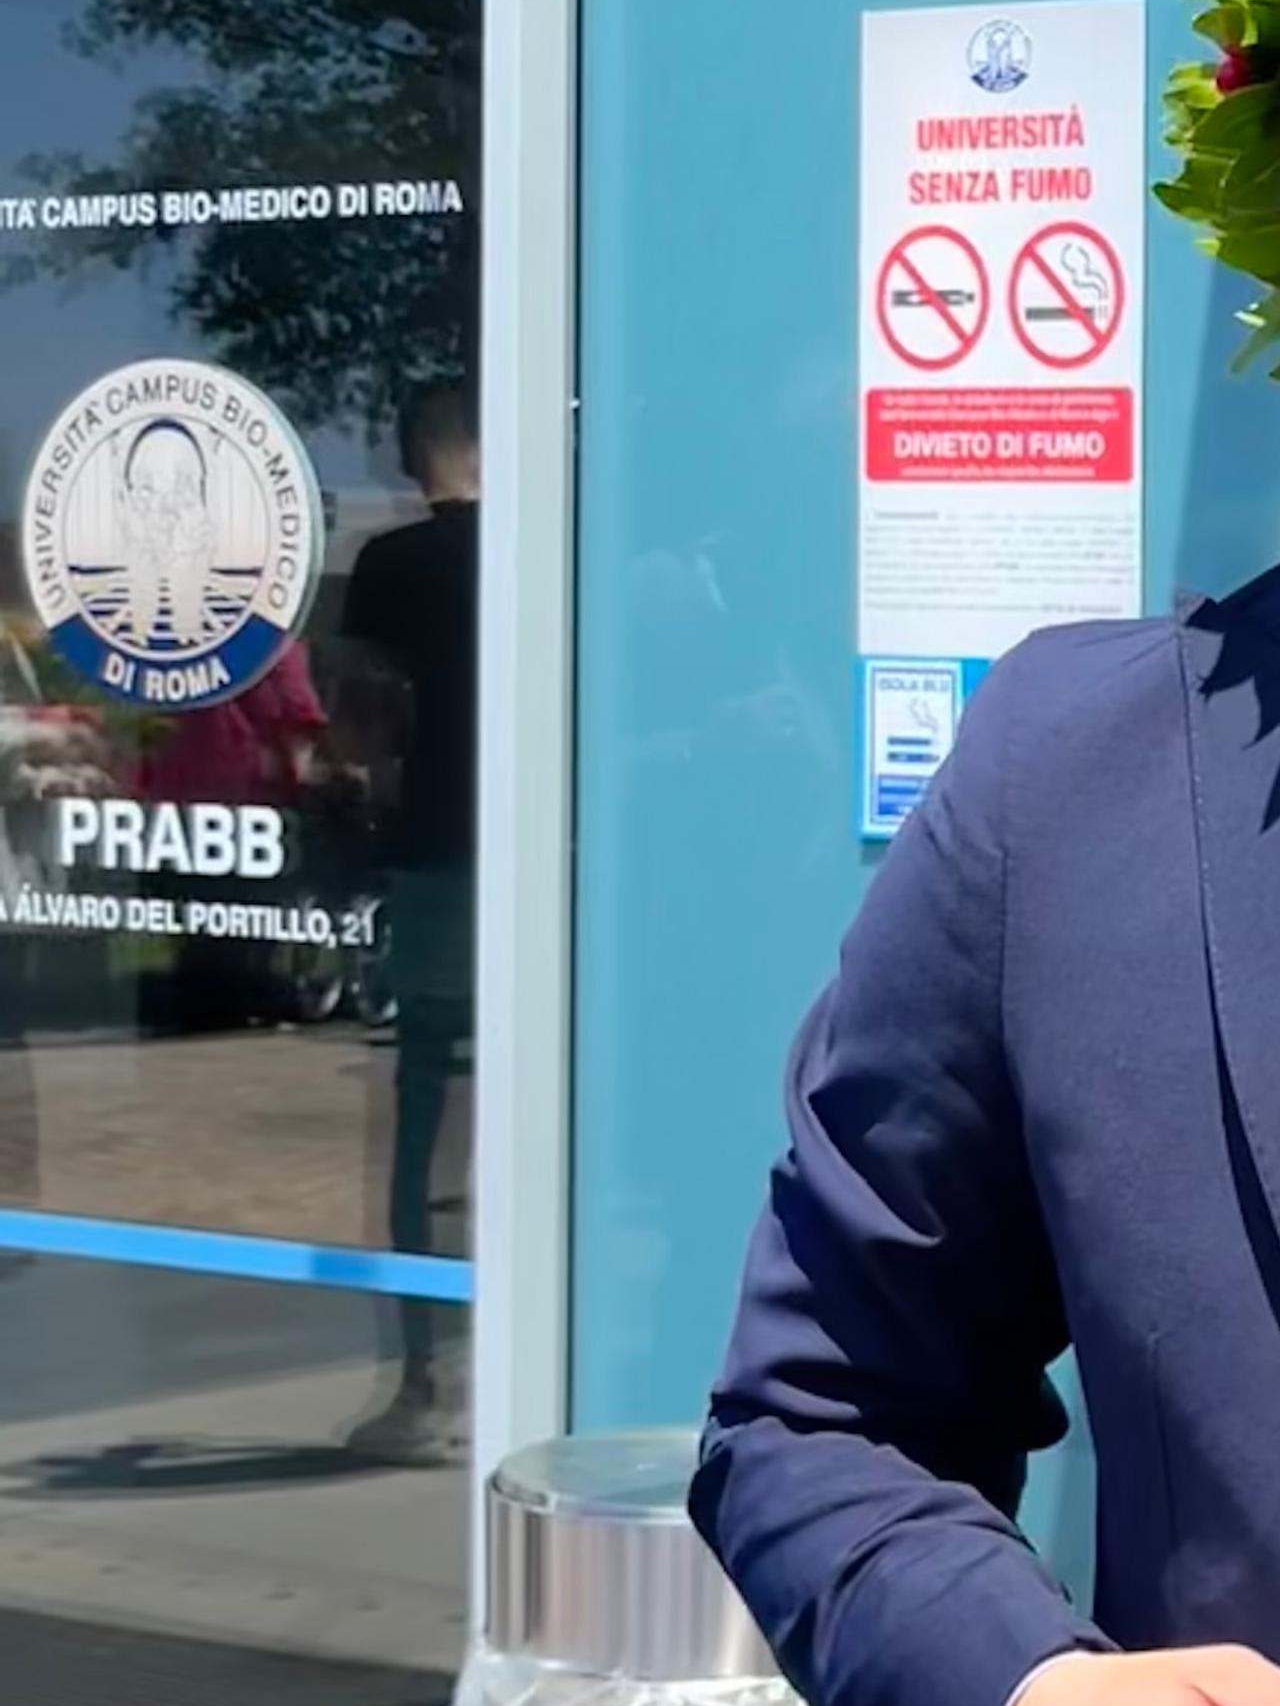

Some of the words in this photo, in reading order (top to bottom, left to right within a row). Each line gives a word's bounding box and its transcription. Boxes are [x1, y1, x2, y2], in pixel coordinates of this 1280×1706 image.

[40, 192, 157, 229] CAMPUS
[162, 185, 332, 225] BIO-MEDICO
[338, 184, 367, 218] DI
[375, 180, 463, 216] ROMA
[909, 169, 1000, 204] SENZA
[1011, 166, 1093, 203] FUMO
[893, 430, 992, 460] DIVIETO
[996, 430, 1024, 459] DI
[1027, 429, 1107, 459] FUMO
[34, 400, 104, 610] UNIVERSITÀ
[105, 373, 218, 416] CAMPUS
[222, 394, 302, 611] BIO-MEDICO
[103, 655, 136, 691] DI
[145, 656, 232, 701] ROMA
[59, 796, 285, 879] PRABB
[14, 882, 121, 930] ÁLVARO
[126, 897, 183, 934] DEL
[189, 901, 338, 949] PORTILLO,
[341, 910, 375, 945] 21
